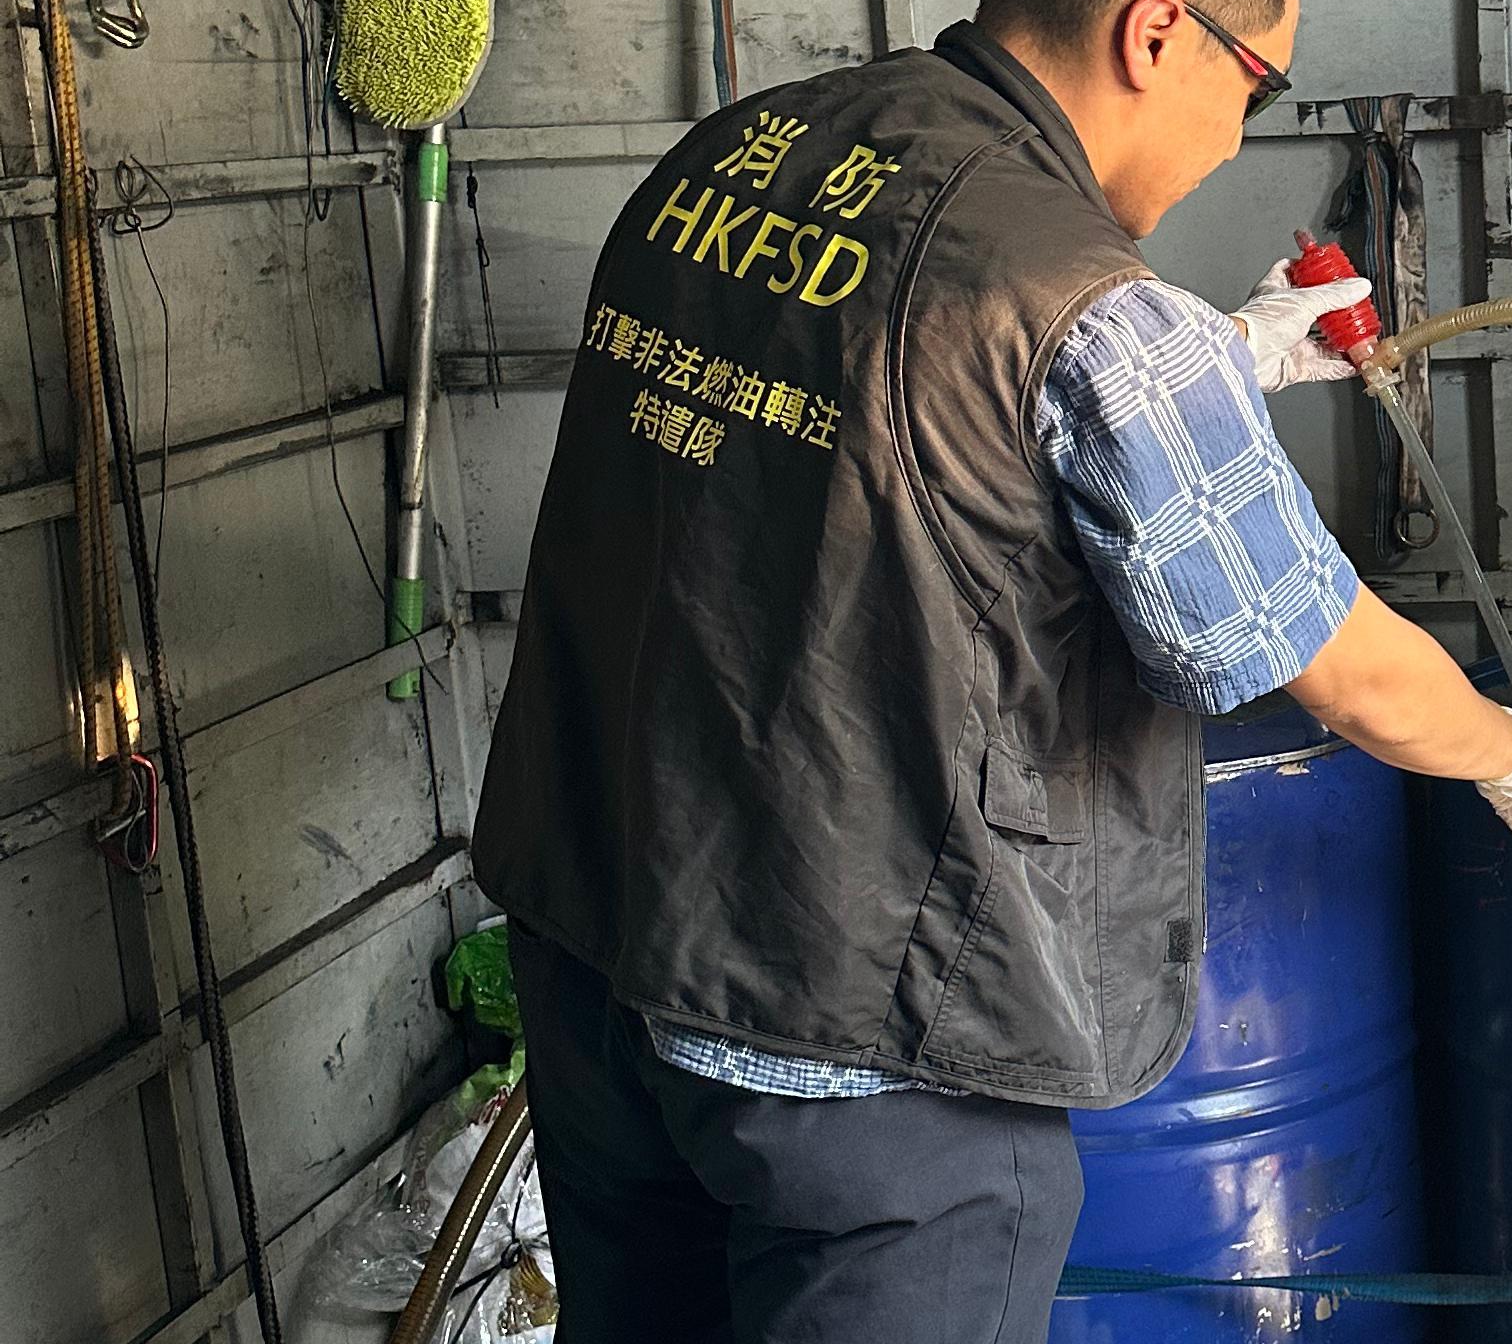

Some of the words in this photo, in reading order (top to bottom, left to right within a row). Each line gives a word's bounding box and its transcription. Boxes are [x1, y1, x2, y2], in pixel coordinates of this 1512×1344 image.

[714, 110, 902, 220] 消防
[646, 178, 870, 307] HKFSD
[586, 302, 842, 451] 打擊非法燃油轉注
[629, 388, 726, 467] 特遣隊
